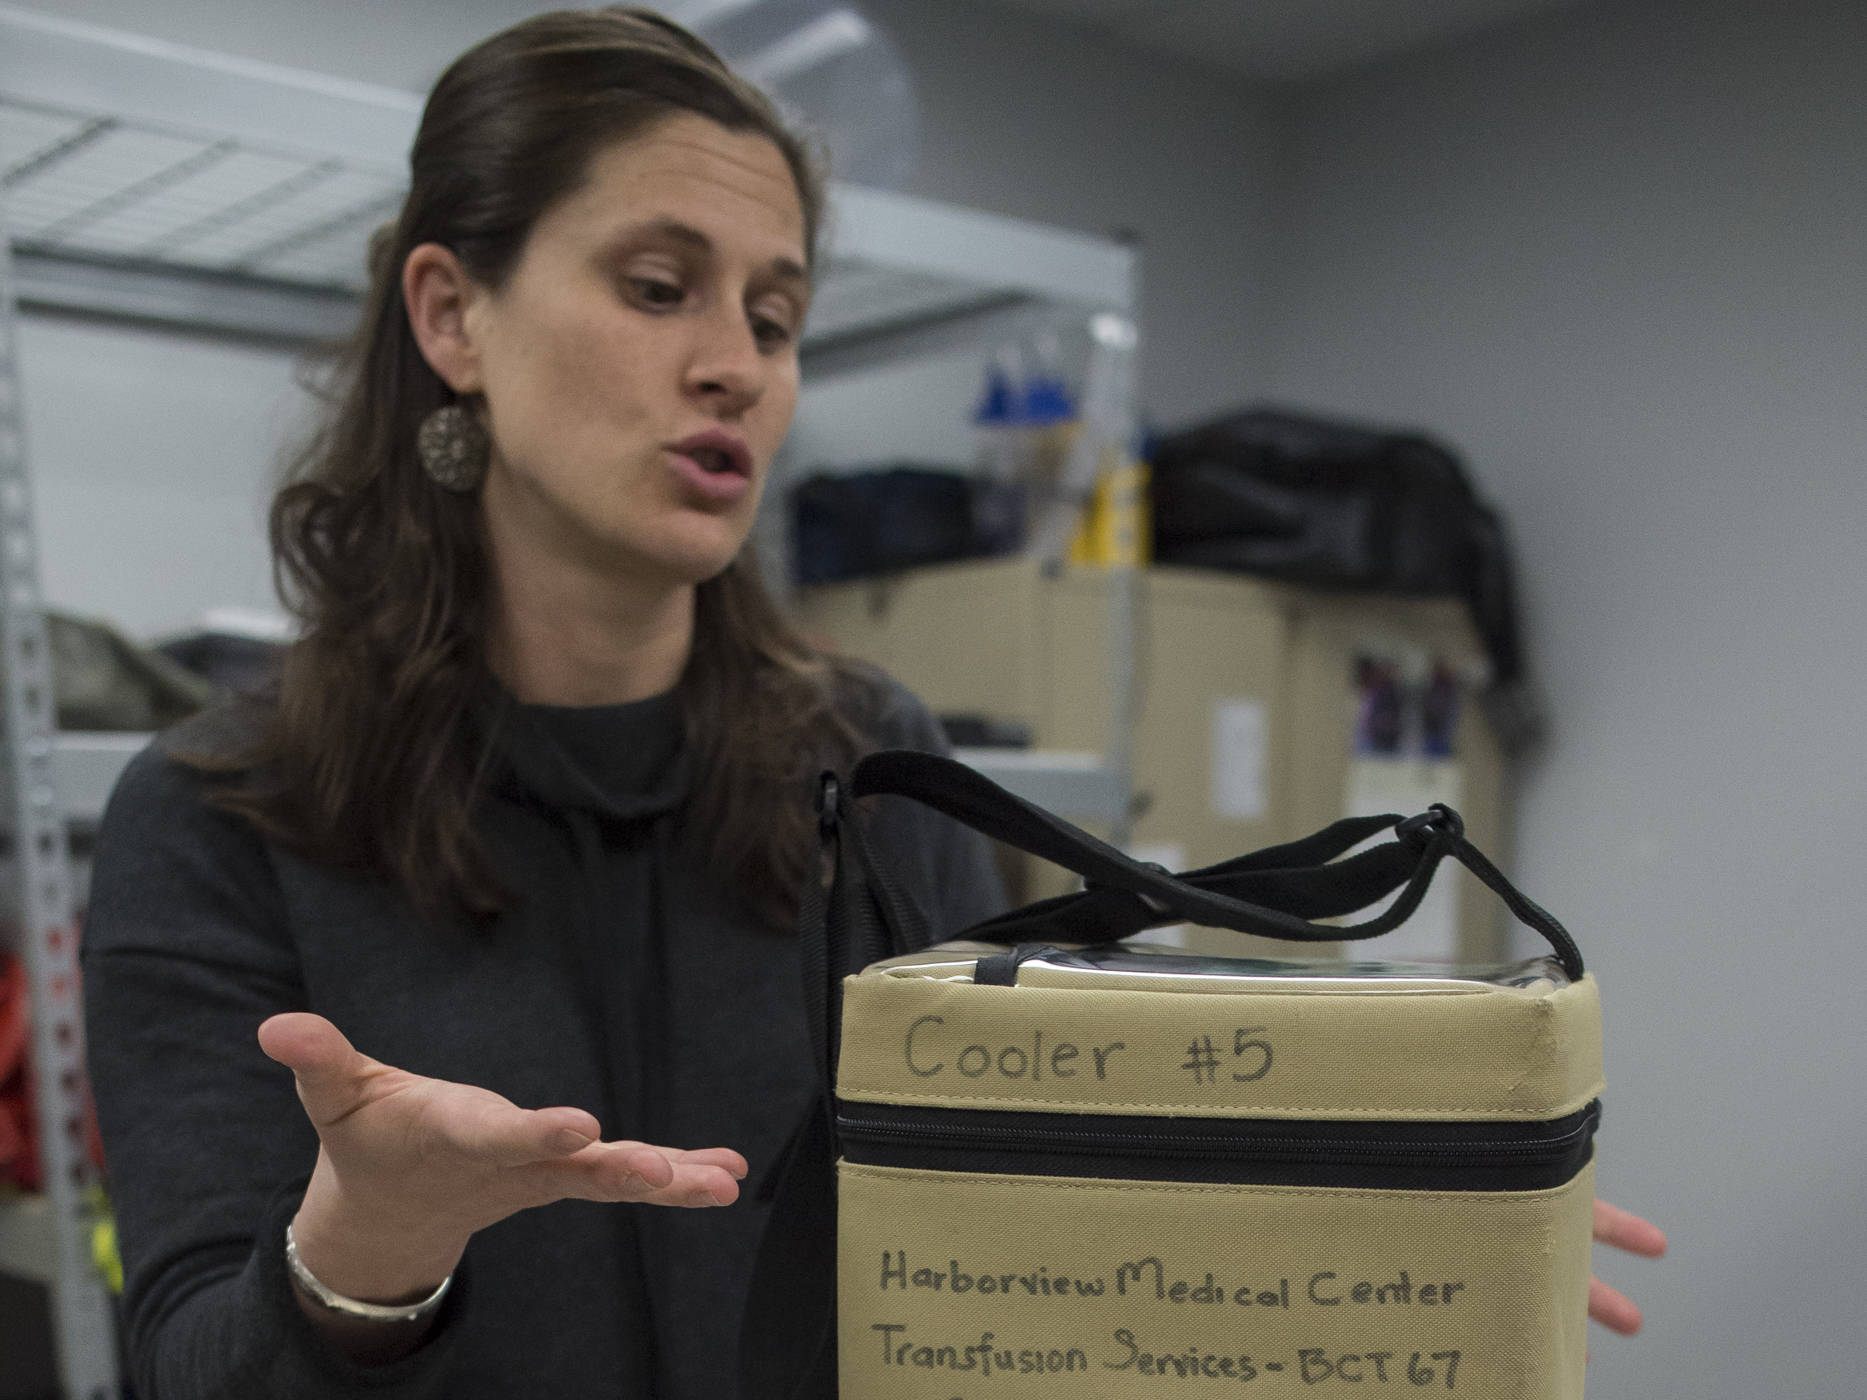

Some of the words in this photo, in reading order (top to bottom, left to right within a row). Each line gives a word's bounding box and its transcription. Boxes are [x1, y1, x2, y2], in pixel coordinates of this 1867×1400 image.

[904, 1015, 1126, 1082] Cooler
[1181, 1025, 1275, 1084] #5
[880, 1250, 1104, 1297] Harborview
[1116, 1256, 1289, 1309] Medical
[1308, 1271, 1465, 1306] Center
[872, 1324, 1088, 1377] Transfusion
[1298, 1348, 1393, 1385] BCT
[1407, 1350, 1461, 1389] 67
